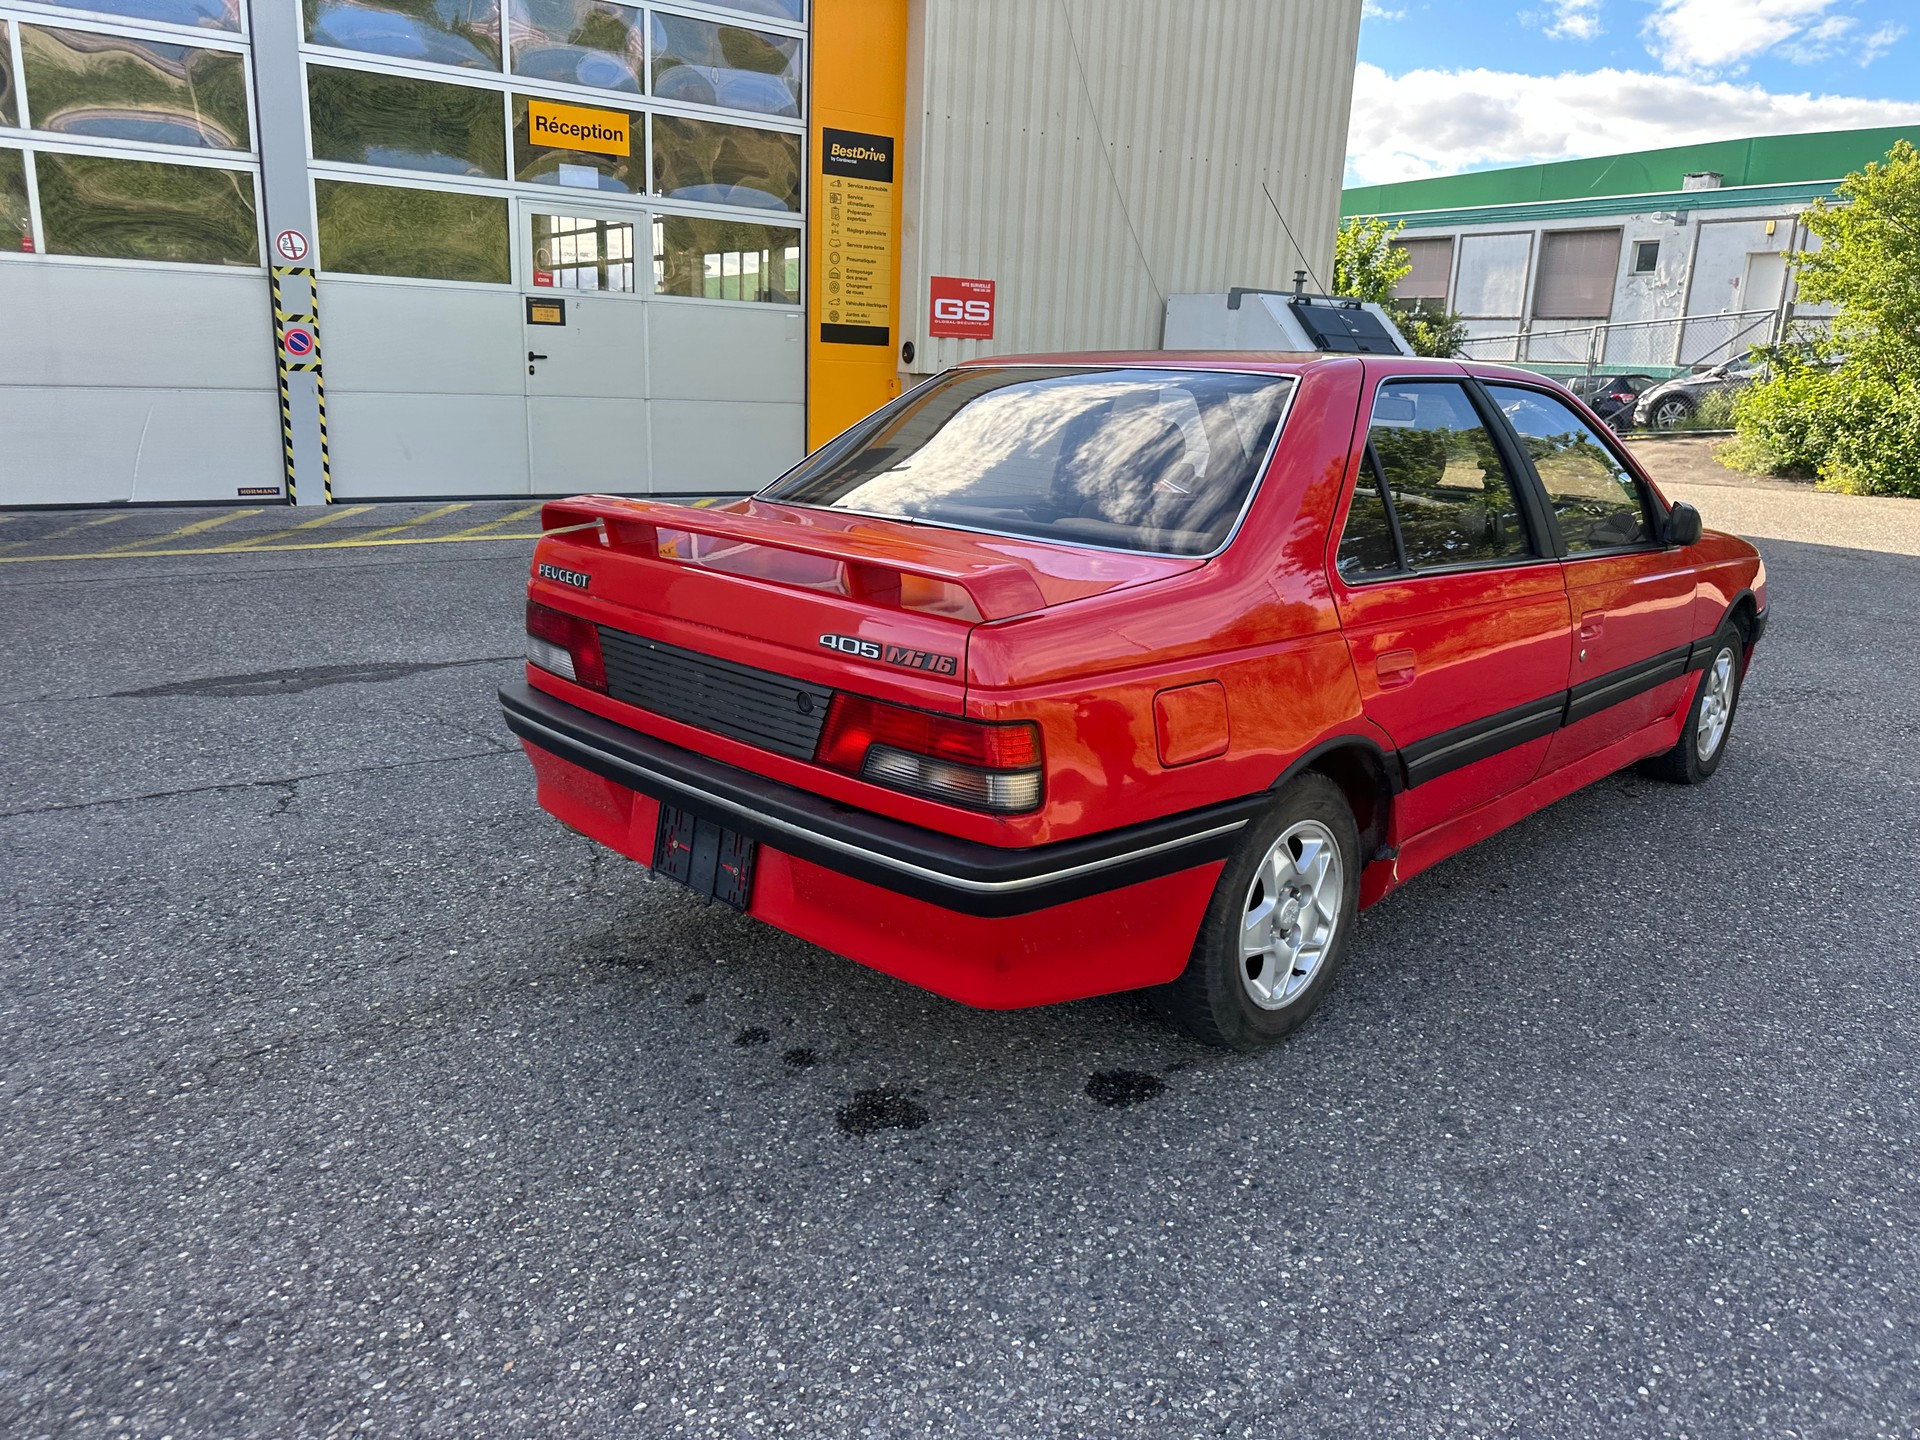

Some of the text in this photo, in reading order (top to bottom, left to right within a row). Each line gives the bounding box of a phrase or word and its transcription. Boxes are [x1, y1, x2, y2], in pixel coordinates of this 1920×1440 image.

[535, 115, 623, 142] Réception
[831, 143, 886, 162] BestDrive
[935, 298, 990, 321] GS
[538, 563, 589, 588] PEUGEOT
[819, 634, 879, 659] 405
